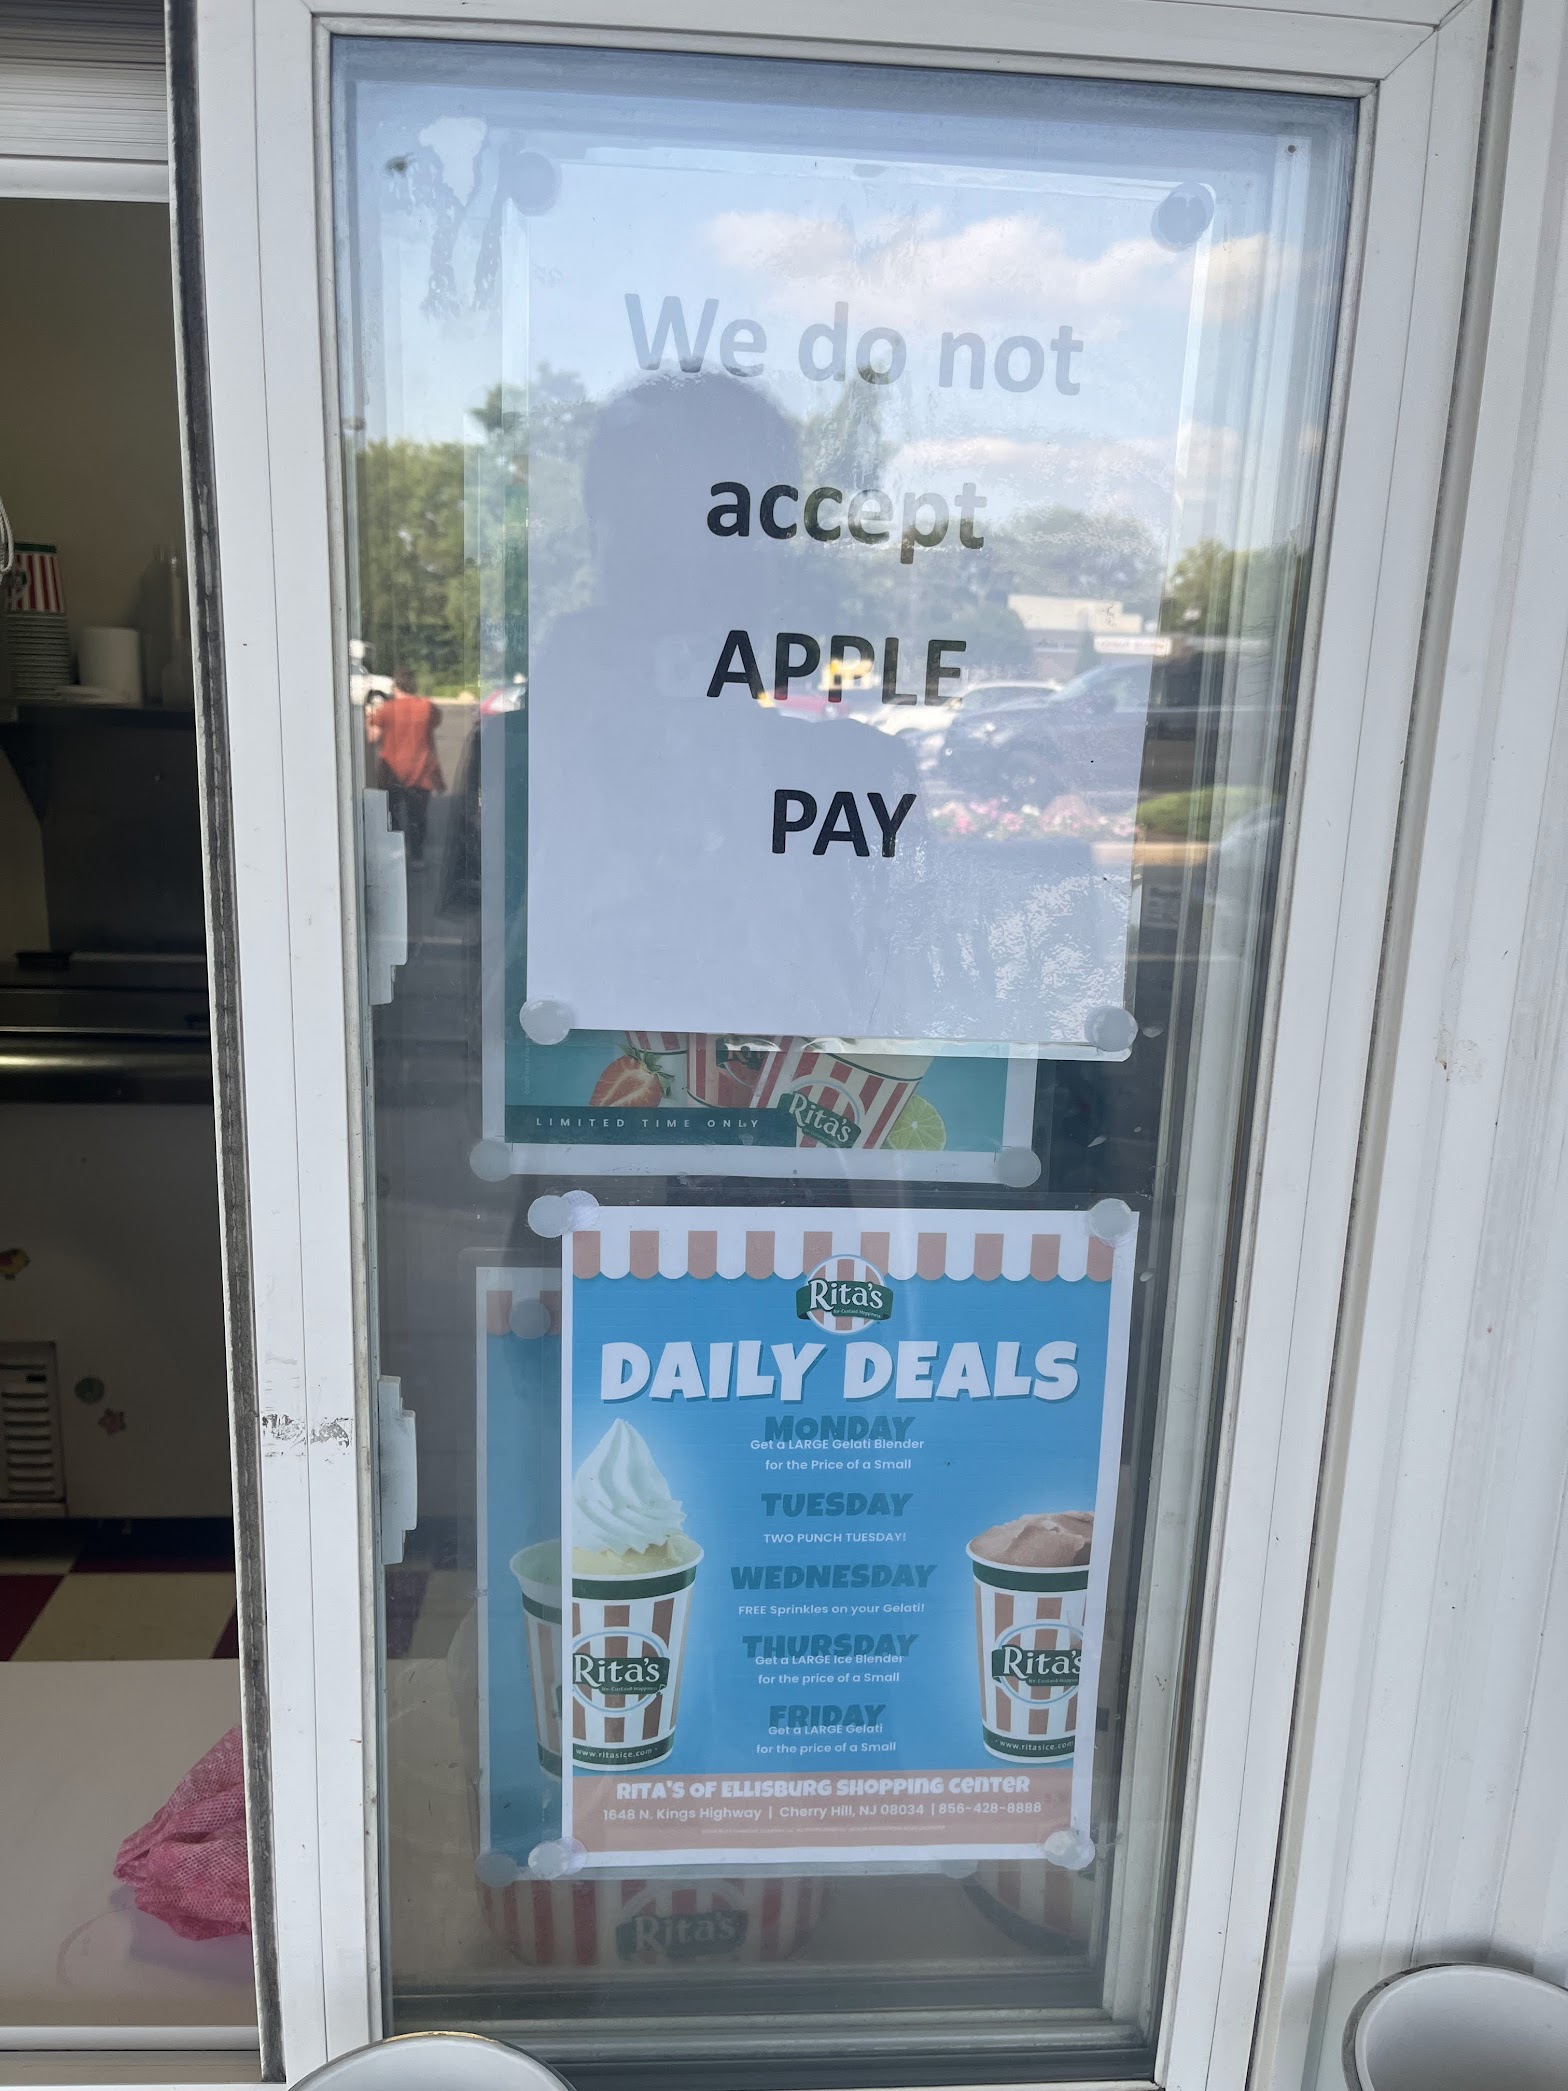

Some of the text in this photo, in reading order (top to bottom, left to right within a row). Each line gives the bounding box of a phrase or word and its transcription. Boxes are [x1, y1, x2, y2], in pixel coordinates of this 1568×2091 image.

[624, 293, 1083, 396] We do not
[706, 479, 987, 565] accept
[706, 630, 967, 706] APPLE
[771, 789, 917, 858] PAY
[536, 1117, 759, 1128] LIMITED TIME ONLY
[789, 1092, 851, 1143] Rita's
[809, 1279, 883, 1311] Rita's
[601, 1340, 1081, 1401] DAILY DEALS
[764, 1415, 916, 1441] MONDAY
[750, 1438, 924, 1450] Get a LARGE Gelati Blender
[765, 1459, 912, 1470] for the Price of a Small
[761, 1492, 914, 1517] TUESDAY
[763, 1532, 906, 1543] TWO PUNCH TUESDAY!
[730, 1564, 938, 1590] WEDNESDAY
[738, 1603, 925, 1617] FREE Sprinkles on your Gelati!
[742, 1633, 919, 1659] THURSDAY
[574, 1654, 660, 1688] Rita's
[755, 1654, 905, 1665] Get a LARGE Ice Blender
[758, 1672, 900, 1686] for the price of a Small
[768, 1704, 887, 1729] FRIDAY
[768, 1723, 883, 1735] Get a LARGE Gelati
[575, 1748, 652, 1759] www.ritasice.com
[756, 1742, 896, 1755] for the price of a Small
[1000, 1740, 1074, 1751] www.ritasice.com
[616, 1780, 685, 1800] RITA'S
[689, 1781, 718, 1798] OF
[721, 1779, 832, 1798] ELLISBURG
[603, 1802, 1042, 1822] 1648 N. Kings Highway Cherry Hill, NJ 08034 856-428-8888
